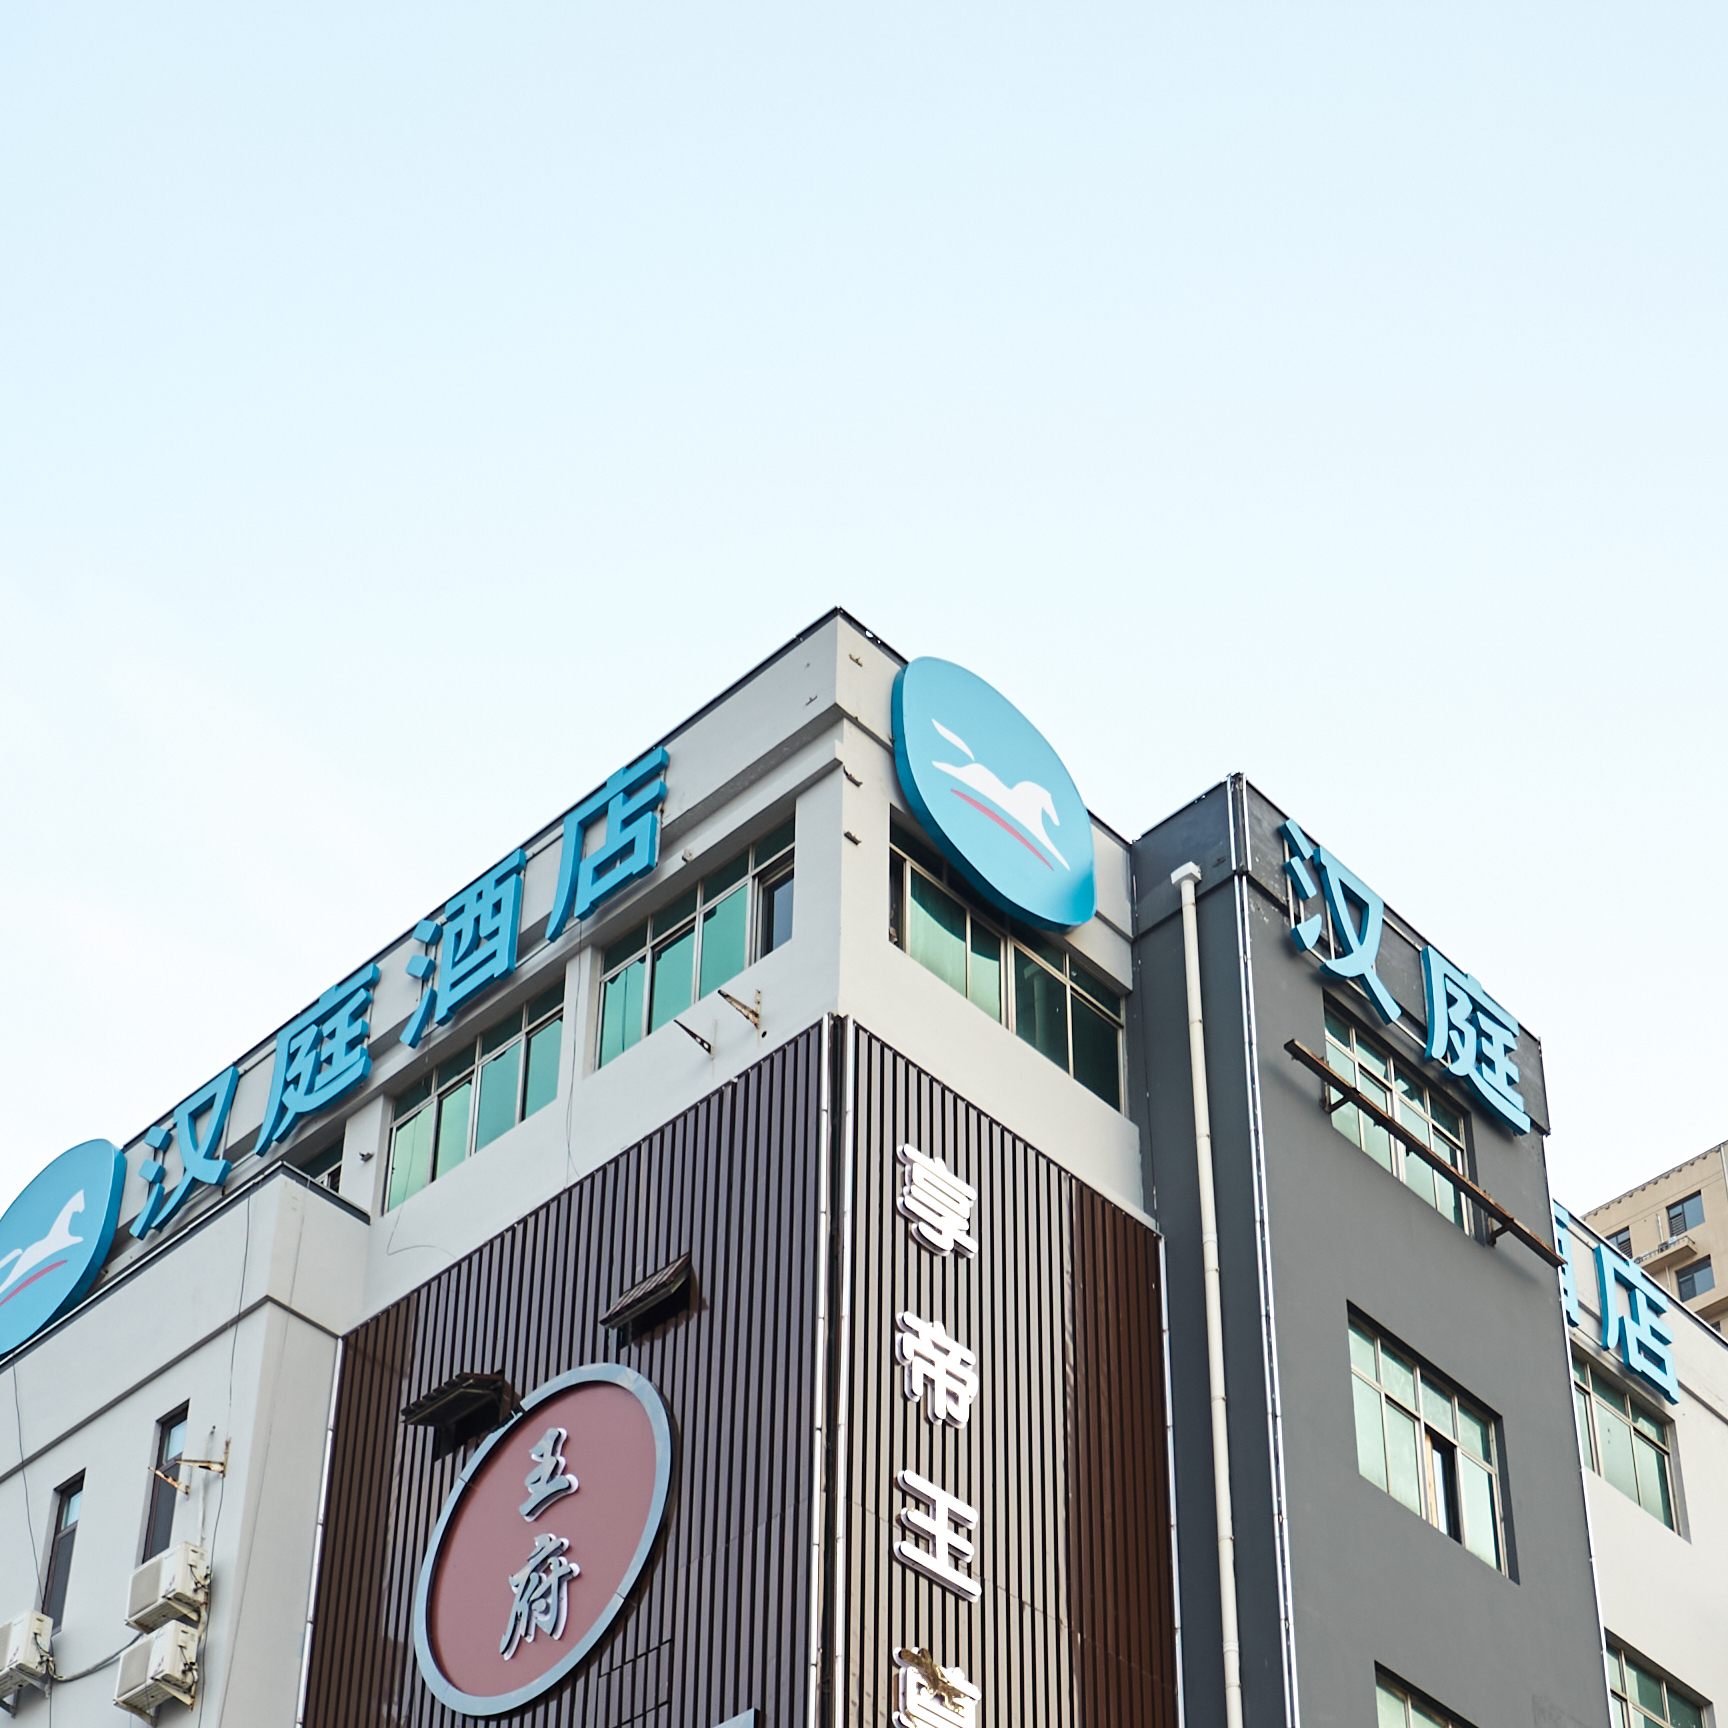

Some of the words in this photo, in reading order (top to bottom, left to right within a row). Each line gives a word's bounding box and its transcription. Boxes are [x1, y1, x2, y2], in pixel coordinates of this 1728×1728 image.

[130, 745, 670, 1241] 汉庭酒店
[1279, 818, 1531, 1136] 汉庭
[500, 1426, 580, 1660] 王府
